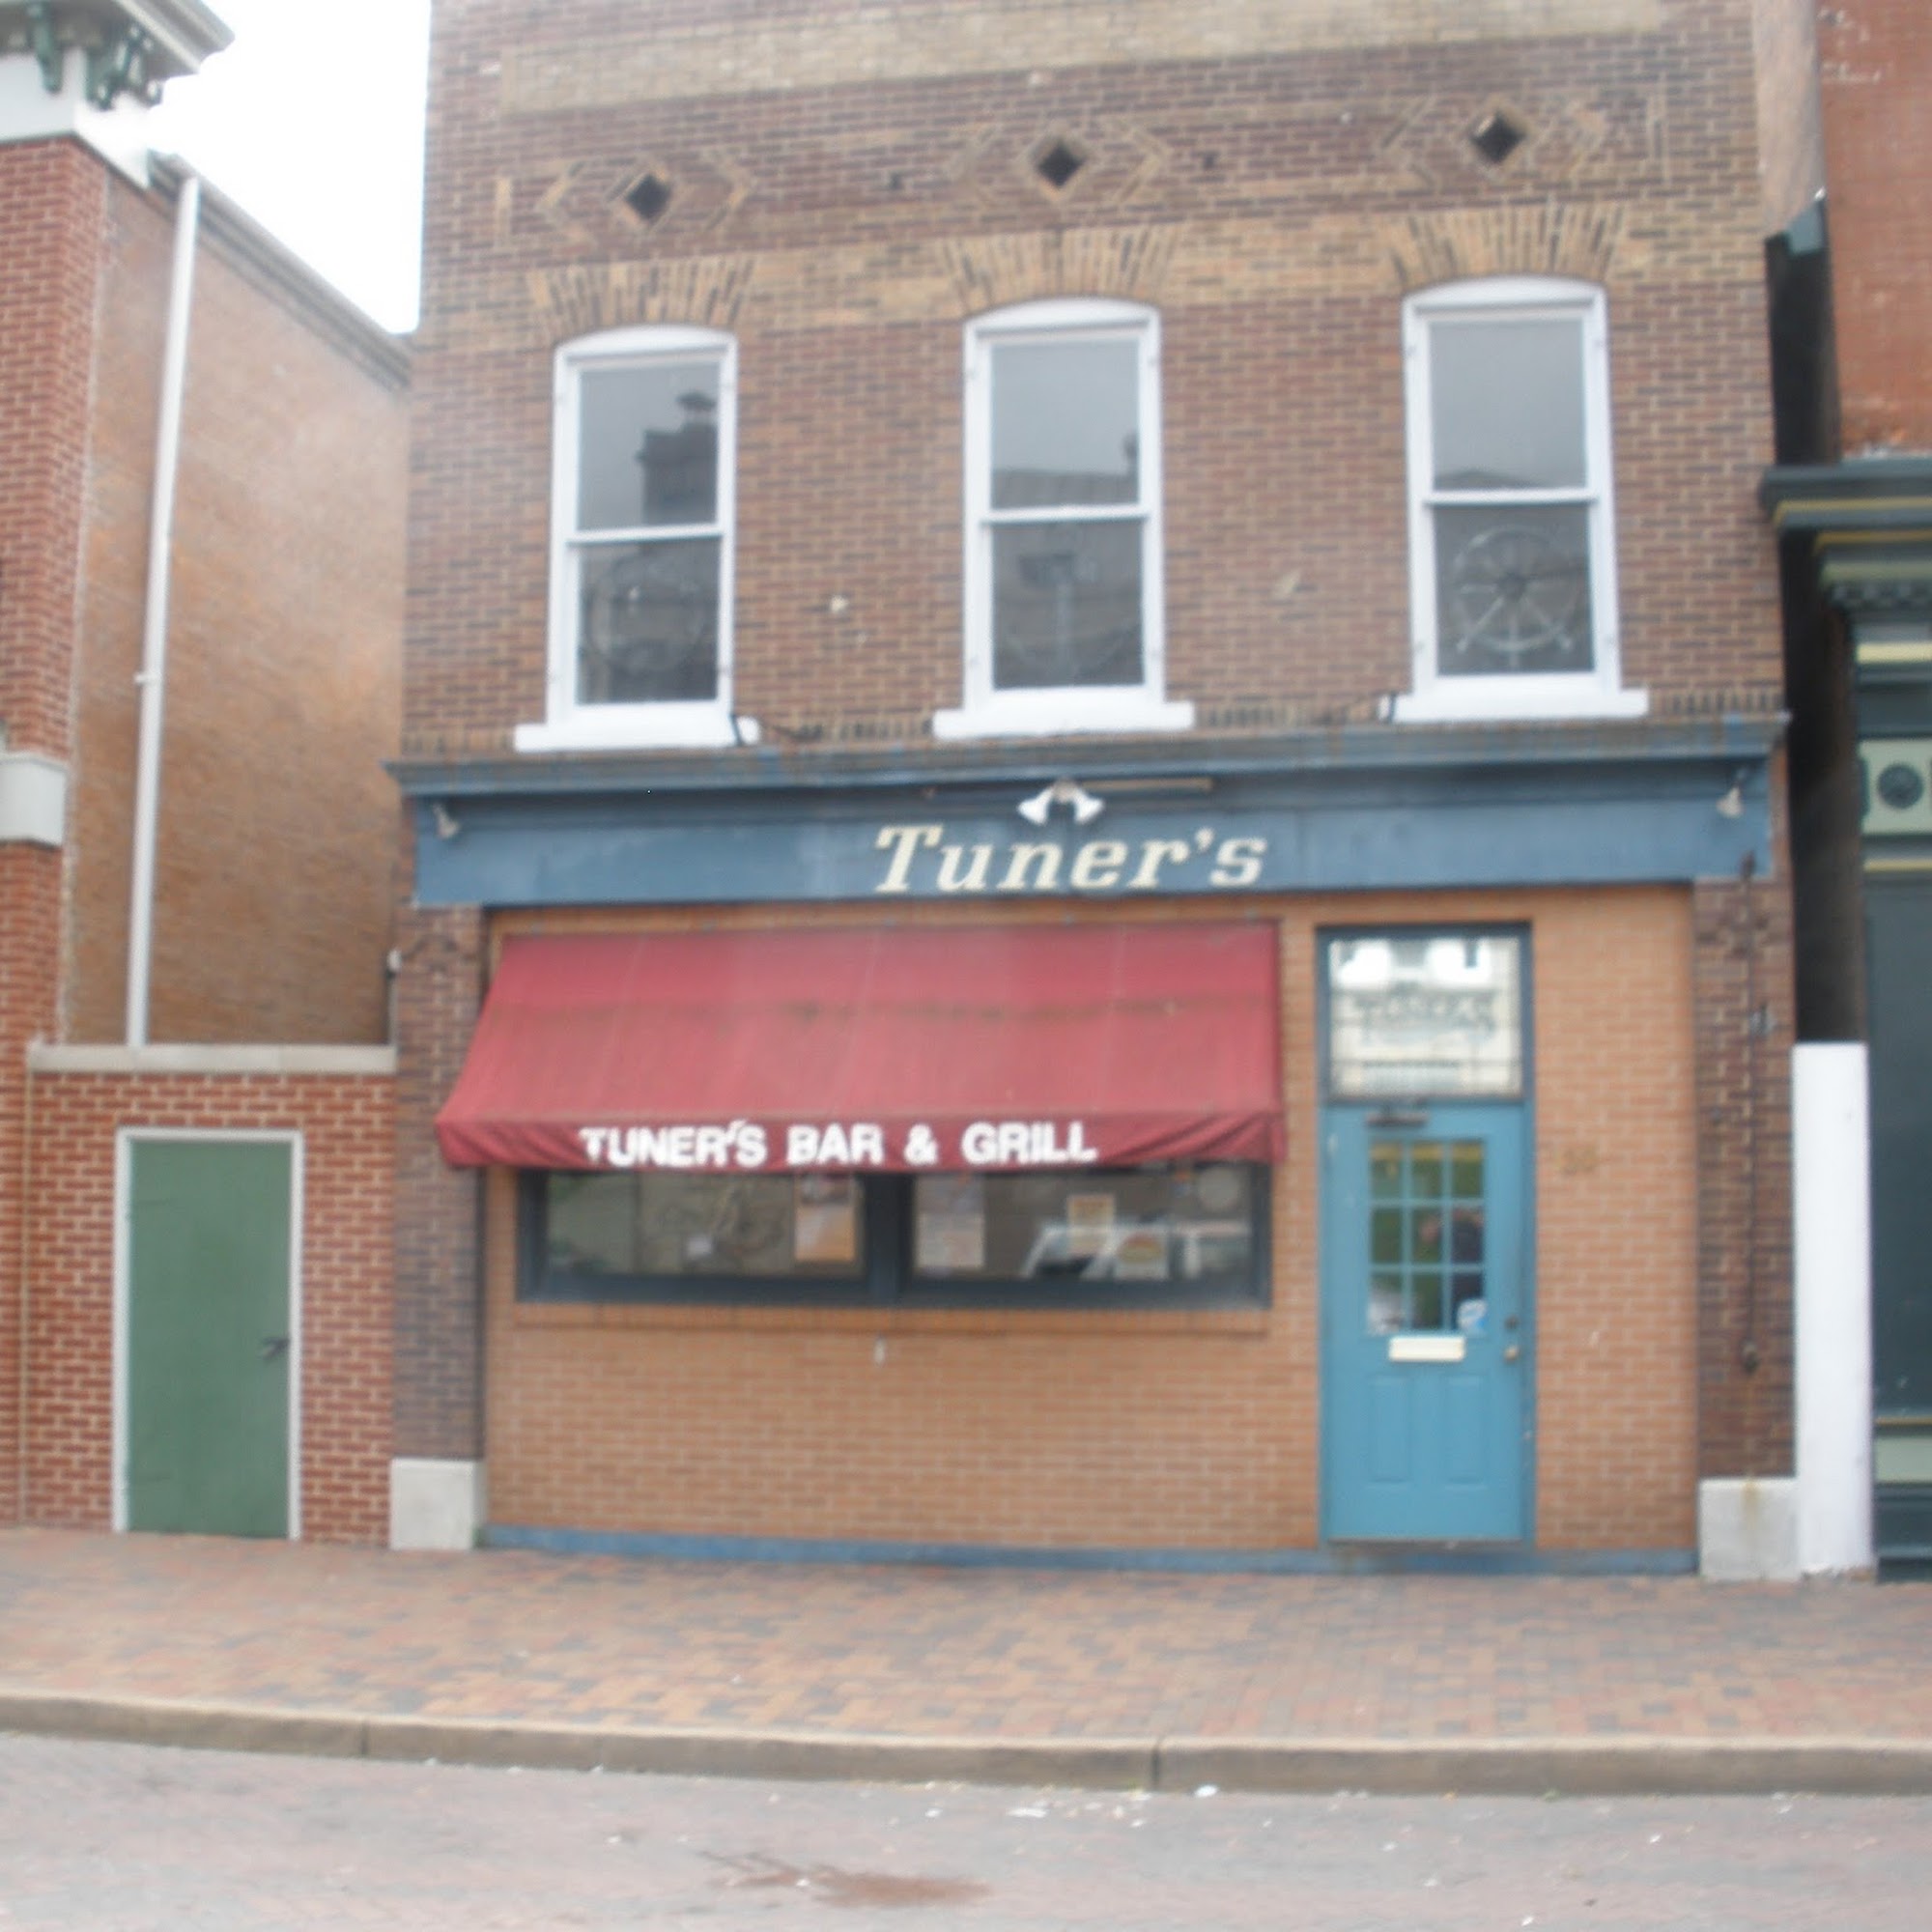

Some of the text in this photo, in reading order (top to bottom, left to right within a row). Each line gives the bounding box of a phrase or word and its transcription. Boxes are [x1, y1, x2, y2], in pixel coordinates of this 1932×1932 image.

[874, 822, 1267, 894] Tuner's
[579, 1119, 1097, 1168] TUNER'S BAR & GRILL
